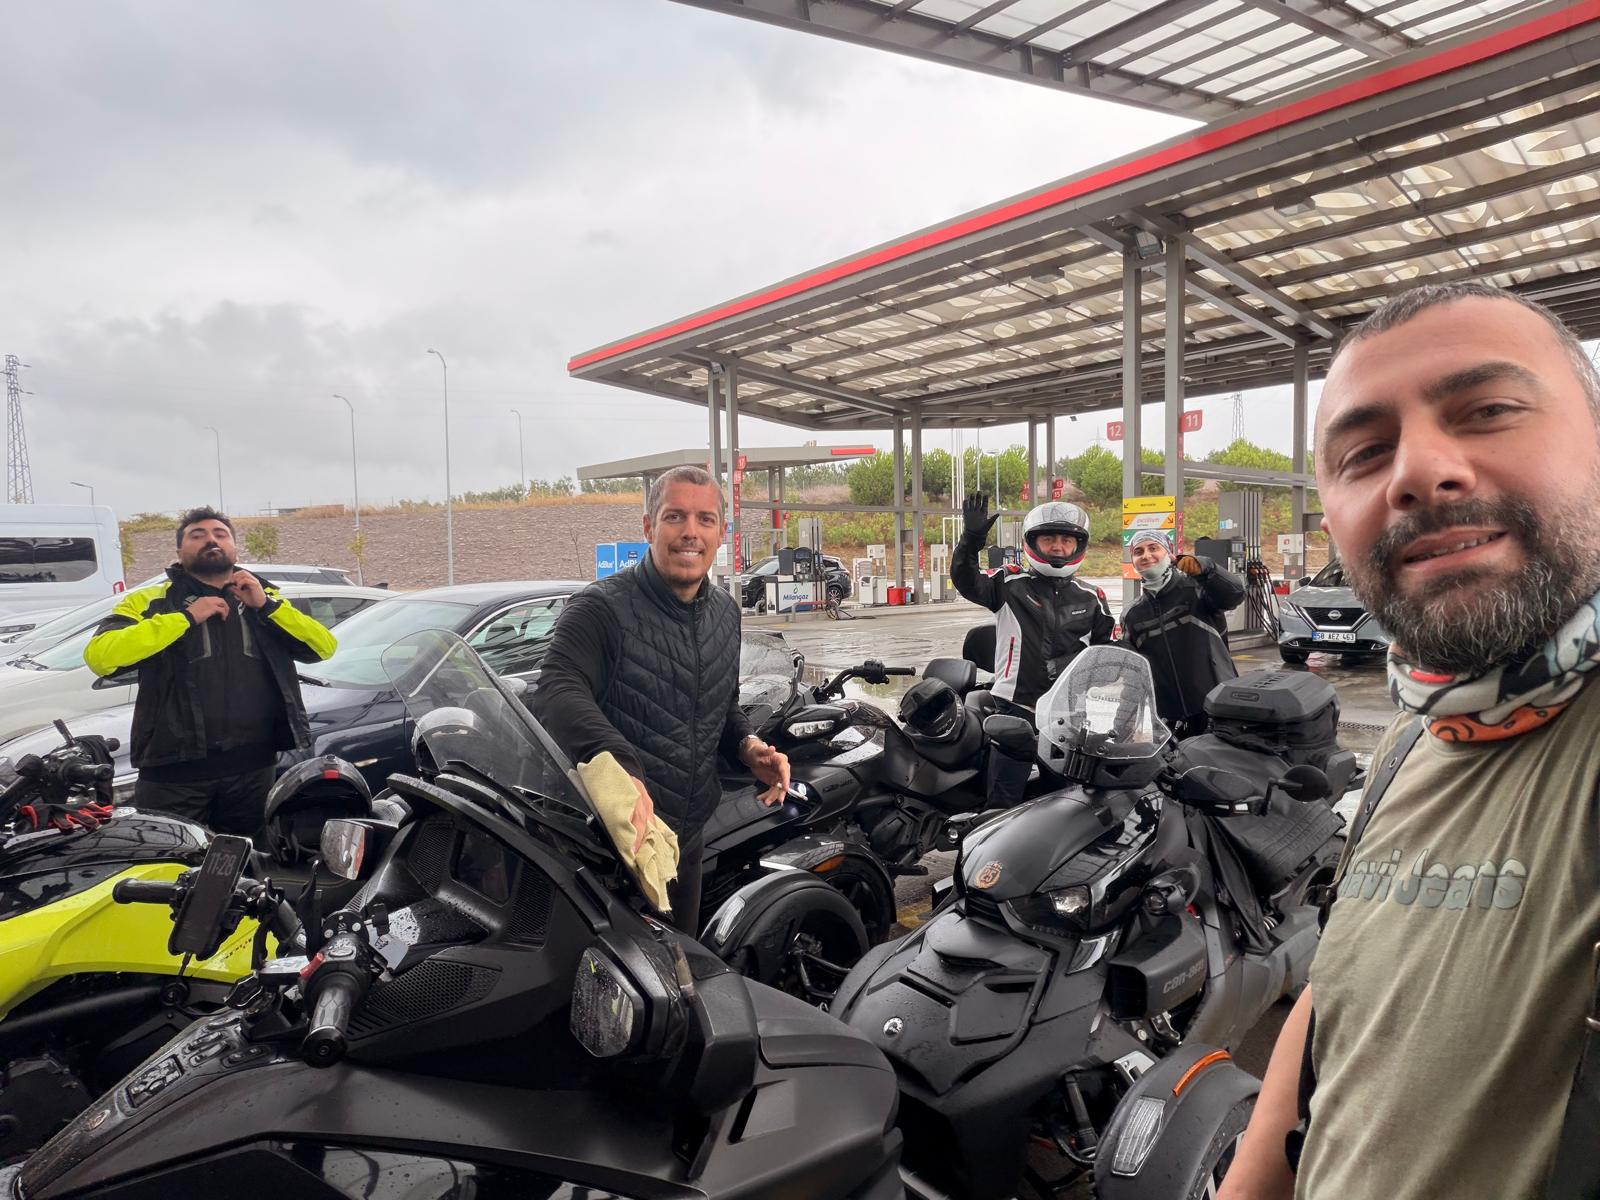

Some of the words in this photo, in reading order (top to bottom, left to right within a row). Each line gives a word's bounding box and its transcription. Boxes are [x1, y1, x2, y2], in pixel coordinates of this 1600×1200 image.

[1185, 413, 1199, 428] 11
[1108, 424, 1122, 438] 12
[782, 593, 809, 601] Milangaz
[206, 853, 237, 876] 11:28
[1393, 848, 1527, 911] Jeans
